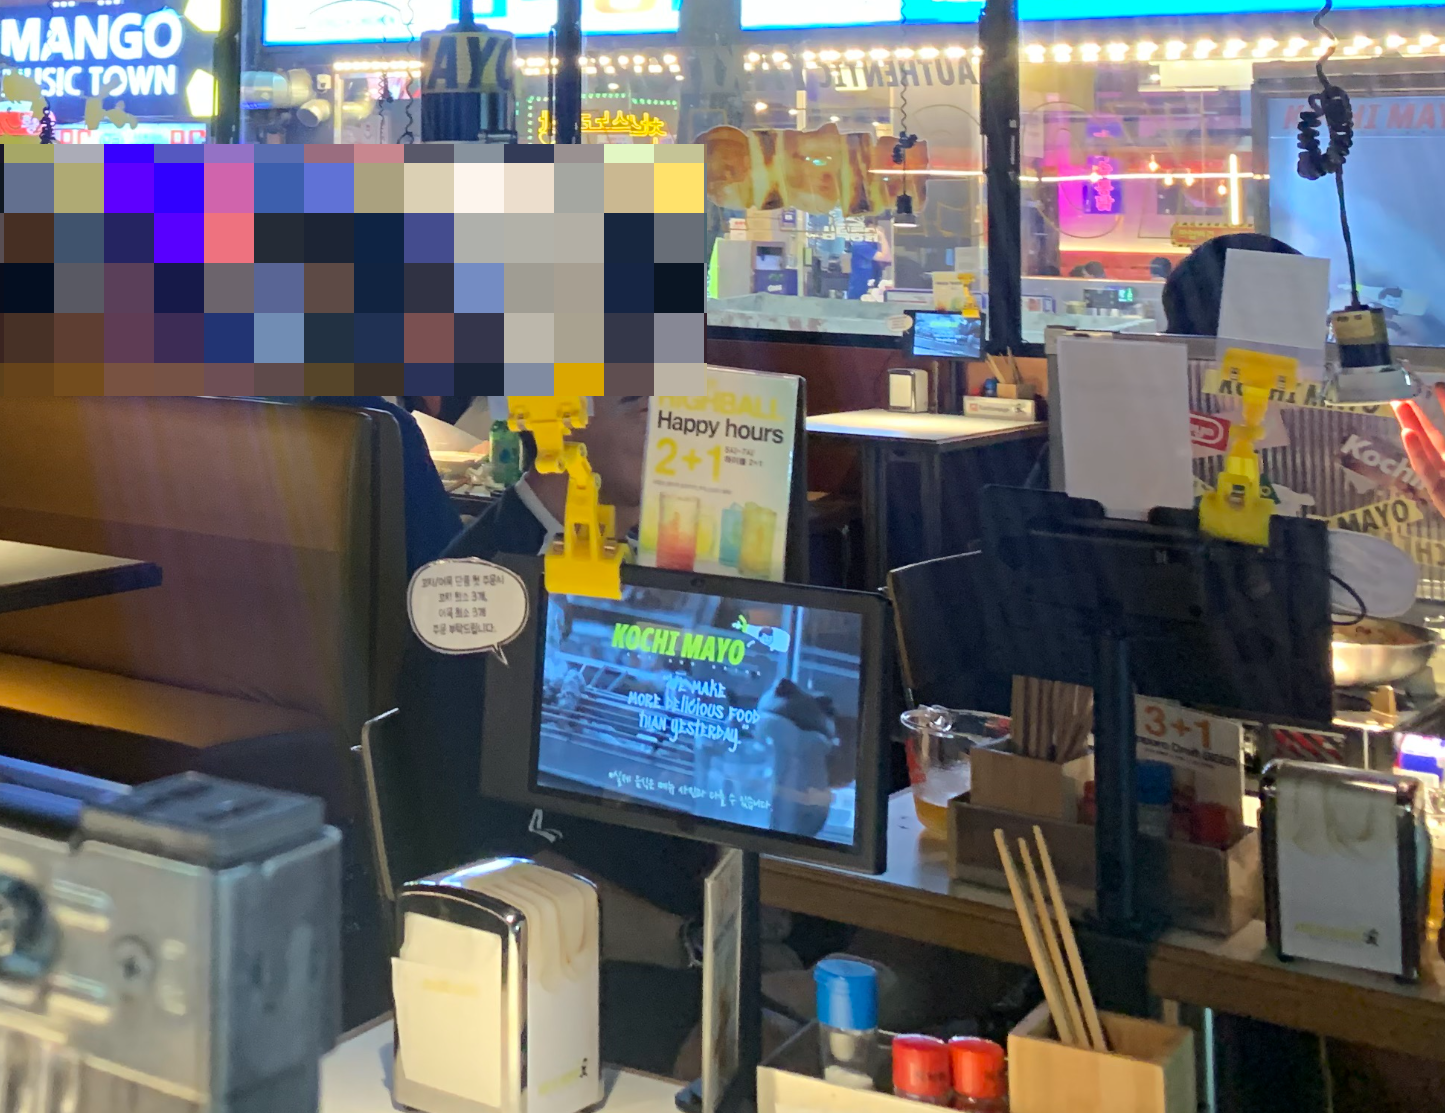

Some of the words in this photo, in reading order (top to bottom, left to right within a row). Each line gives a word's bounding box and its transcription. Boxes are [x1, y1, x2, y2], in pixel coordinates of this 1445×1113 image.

[0, 12, 183, 63] MANGO
[88, 64, 176, 97] TOWN
[658, 391, 786, 422] HIGHBALL
[657, 409, 721, 439] Happy
[725, 417, 785, 445] hours
[654, 436, 722, 483] 2+1
[1337, 499, 1410, 533] MAYO
[611, 623, 680, 657] KOCHI
[681, 633, 746, 666] MAYO
[627, 691, 662, 710] MORE
[728, 706, 761, 724] FOOD
[1144, 704, 1212, 751] 3+1
